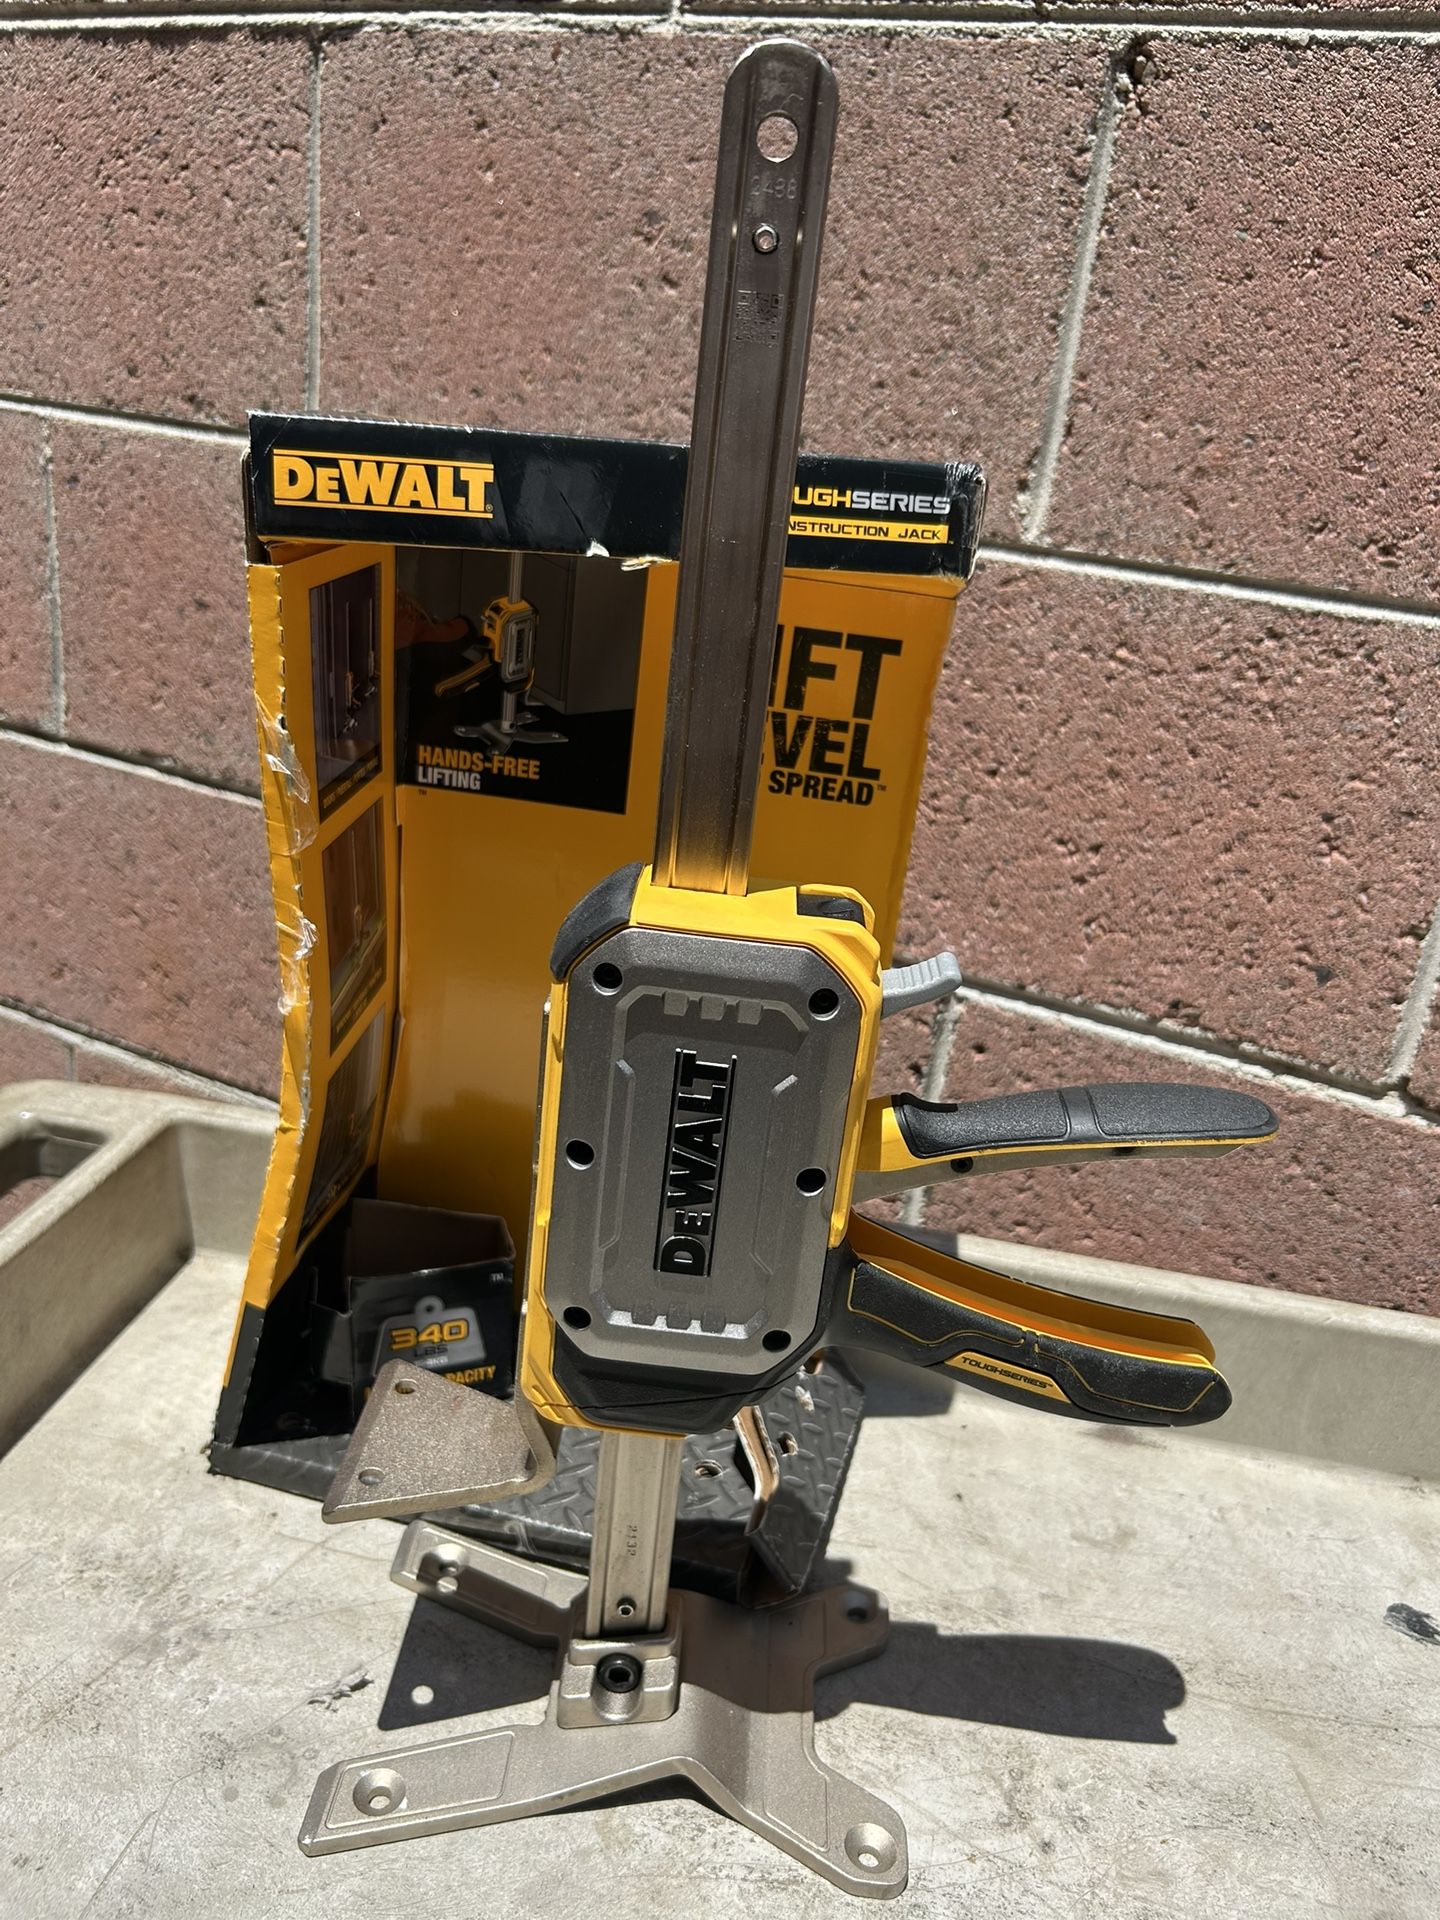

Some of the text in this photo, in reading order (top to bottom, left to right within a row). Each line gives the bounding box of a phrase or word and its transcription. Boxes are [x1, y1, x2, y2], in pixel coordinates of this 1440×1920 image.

[793, 486, 950, 515] UGHSERIES
[898, 528, 941, 541] JACK
[762, 710, 881, 781] VEL
[418, 744, 540, 780] HANDS-FREE
[417, 765, 482, 790] LIFTING
[391, 1318, 469, 1350] 340
[444, 1364, 496, 1384] PACITY
